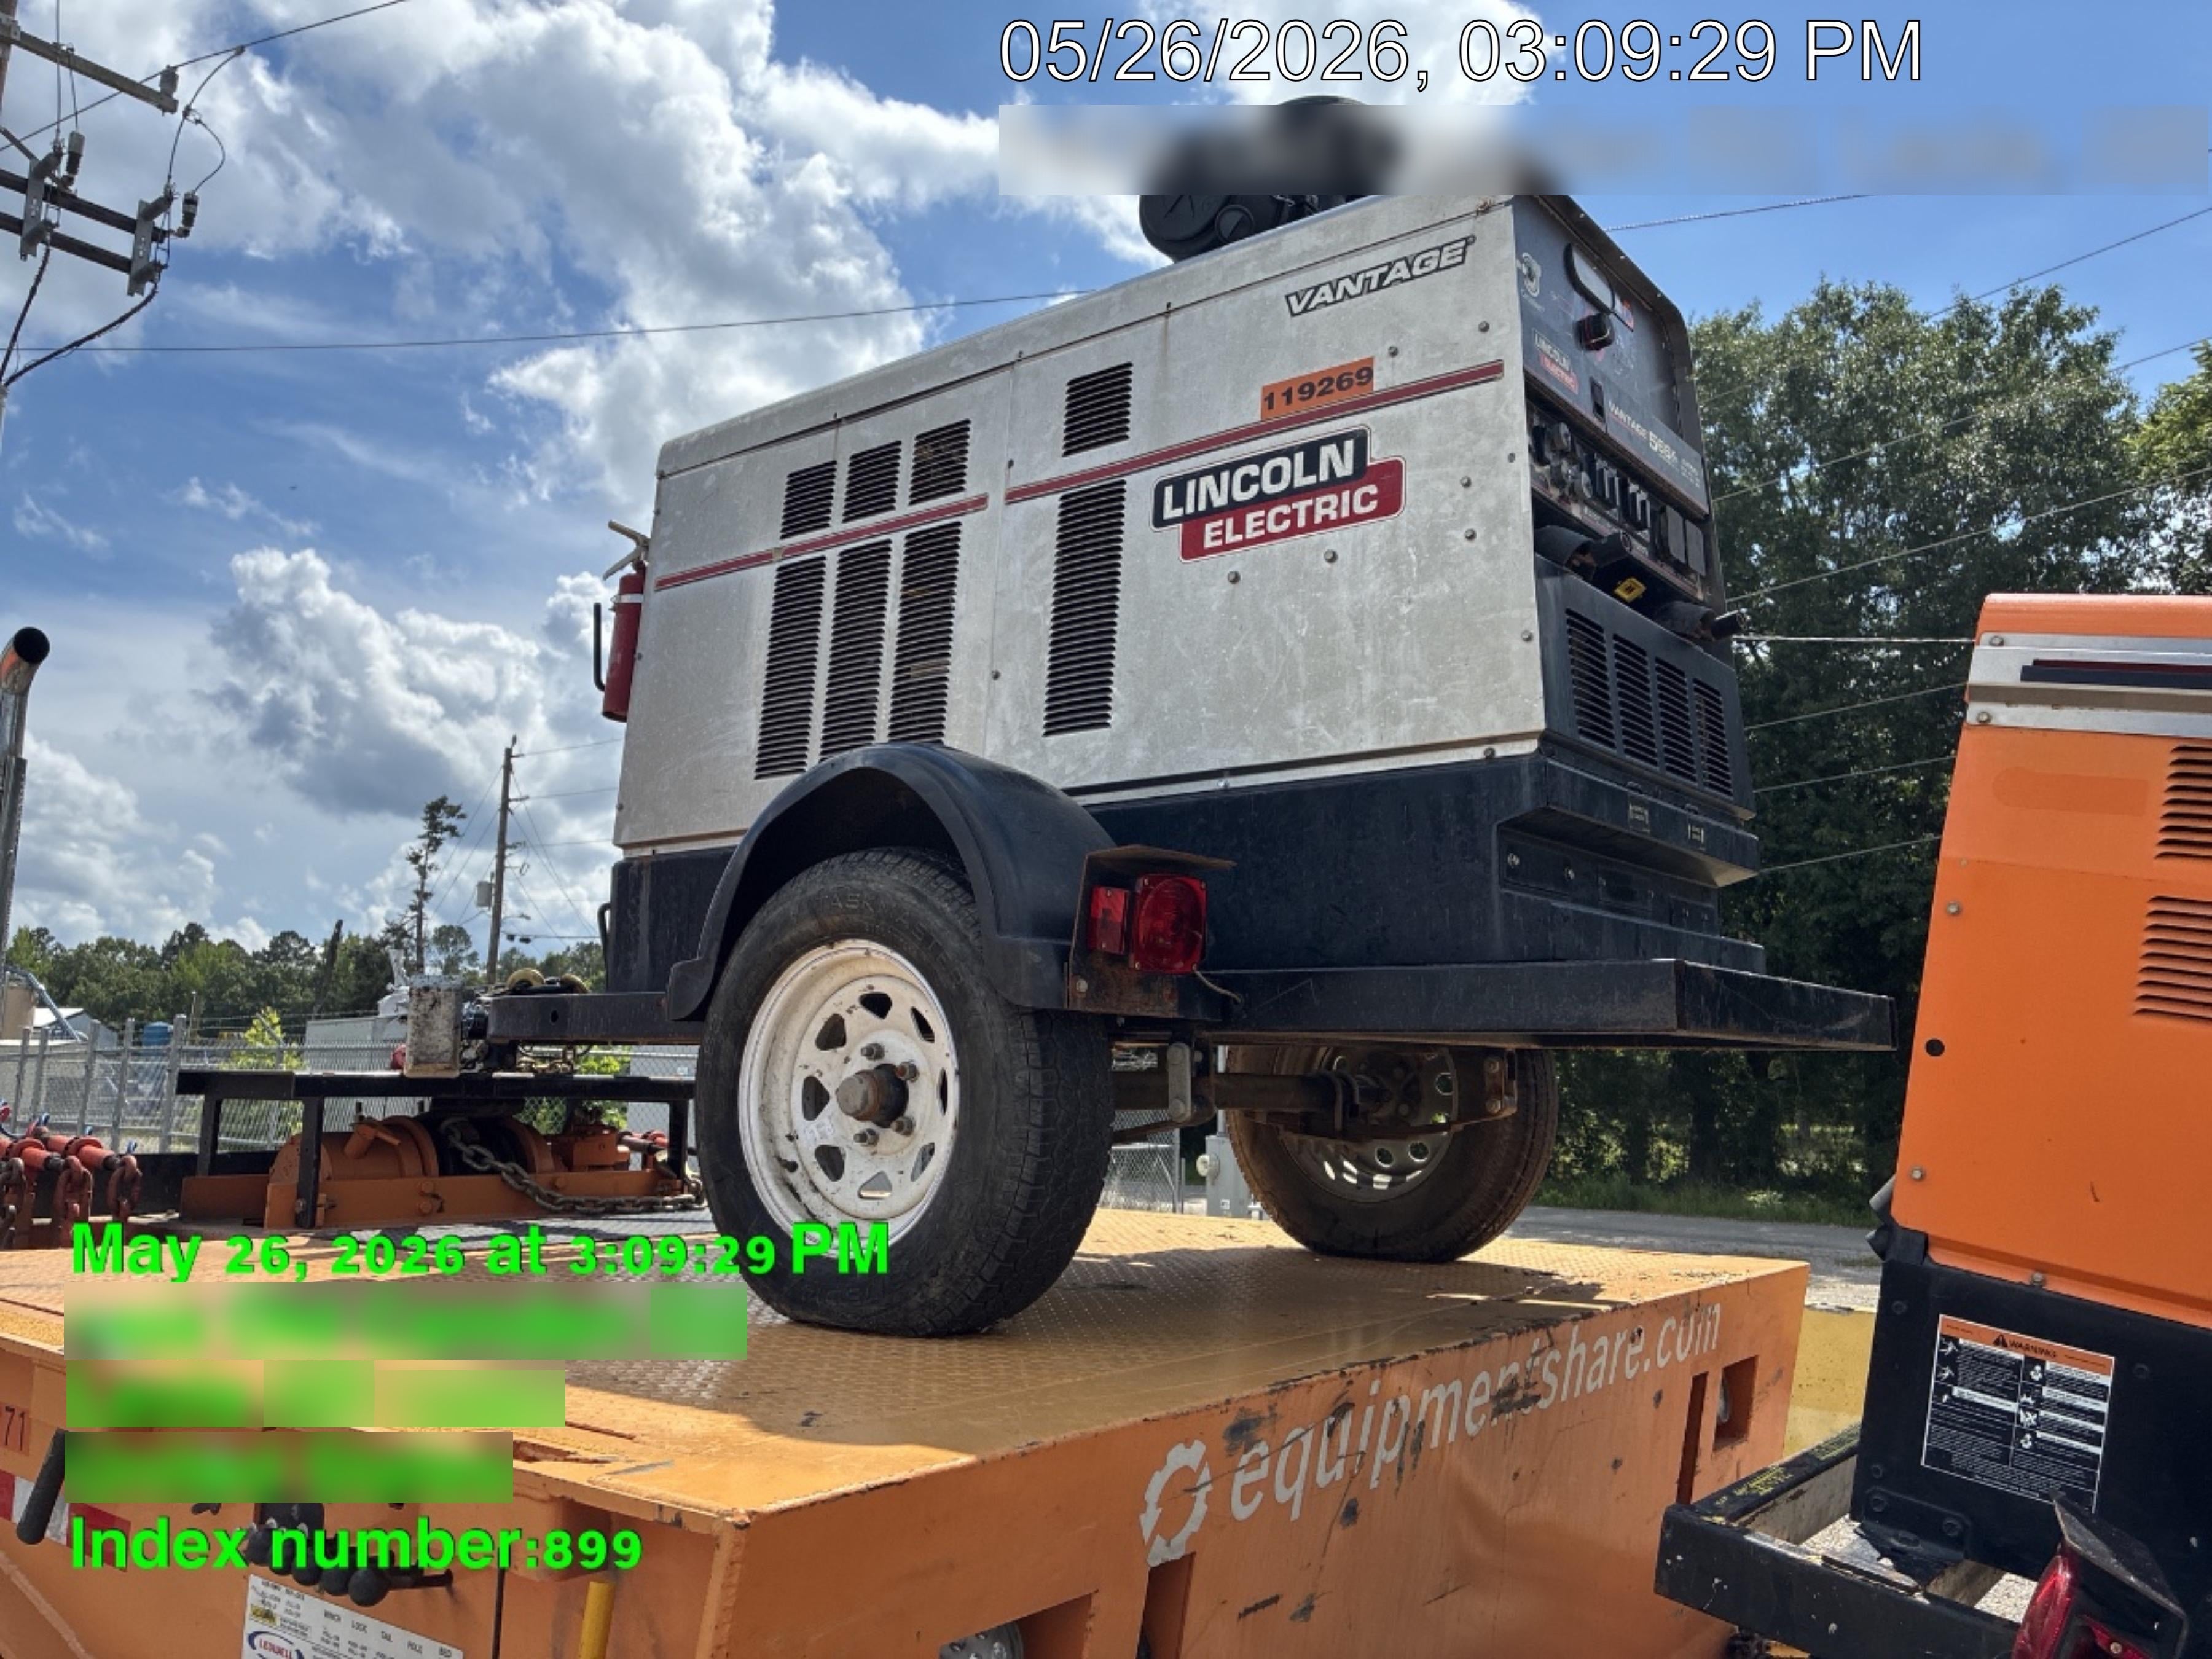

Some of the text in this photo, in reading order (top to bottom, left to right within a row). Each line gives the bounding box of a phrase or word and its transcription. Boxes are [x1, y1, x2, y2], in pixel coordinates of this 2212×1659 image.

[1284, 238, 1471, 316] VANTAGE
[1264, 366, 1374, 410] 119269
[1162, 438, 1355, 521] LINCOLN
[1202, 484, 1378, 549] ELECTRIC
[2009, 1339, 2057, 1359] WARNING
